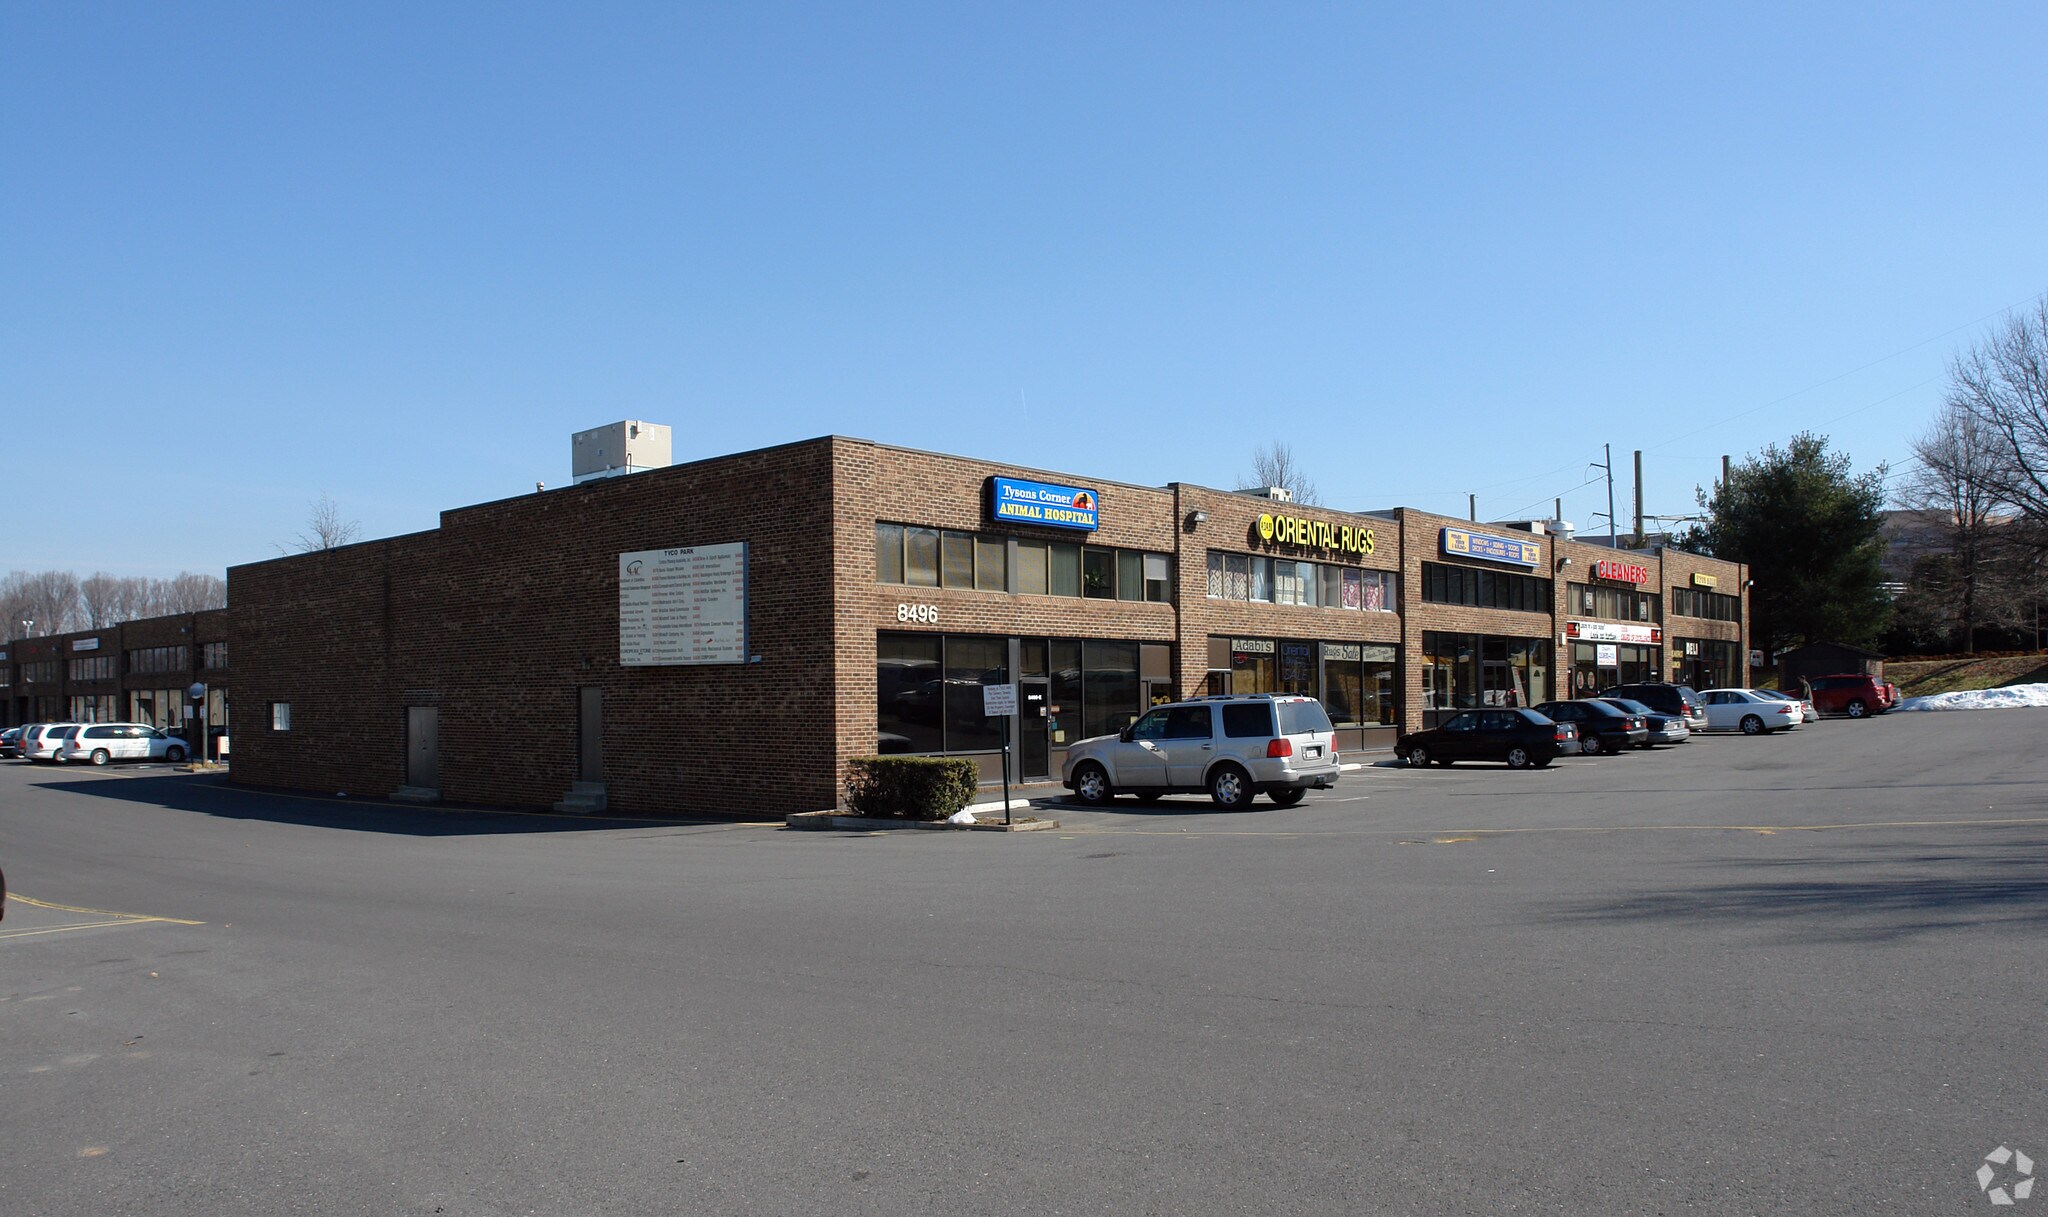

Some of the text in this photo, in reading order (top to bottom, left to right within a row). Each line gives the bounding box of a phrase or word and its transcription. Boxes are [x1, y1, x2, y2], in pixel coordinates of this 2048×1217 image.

[1003, 485, 1071, 504] Tysons Corner
[999, 502, 1095, 525] ANIMAL HOSPITAL
[1275, 514, 1375, 555] ORIENTAL RUGS
[1599, 560, 1647, 584] CLEANERS
[896, 603, 939, 624] 8496
[1235, 640, 1272, 652] Adabi's
[1342, 643, 1359, 660] Sale
[1686, 642, 1699, 655] DELI
